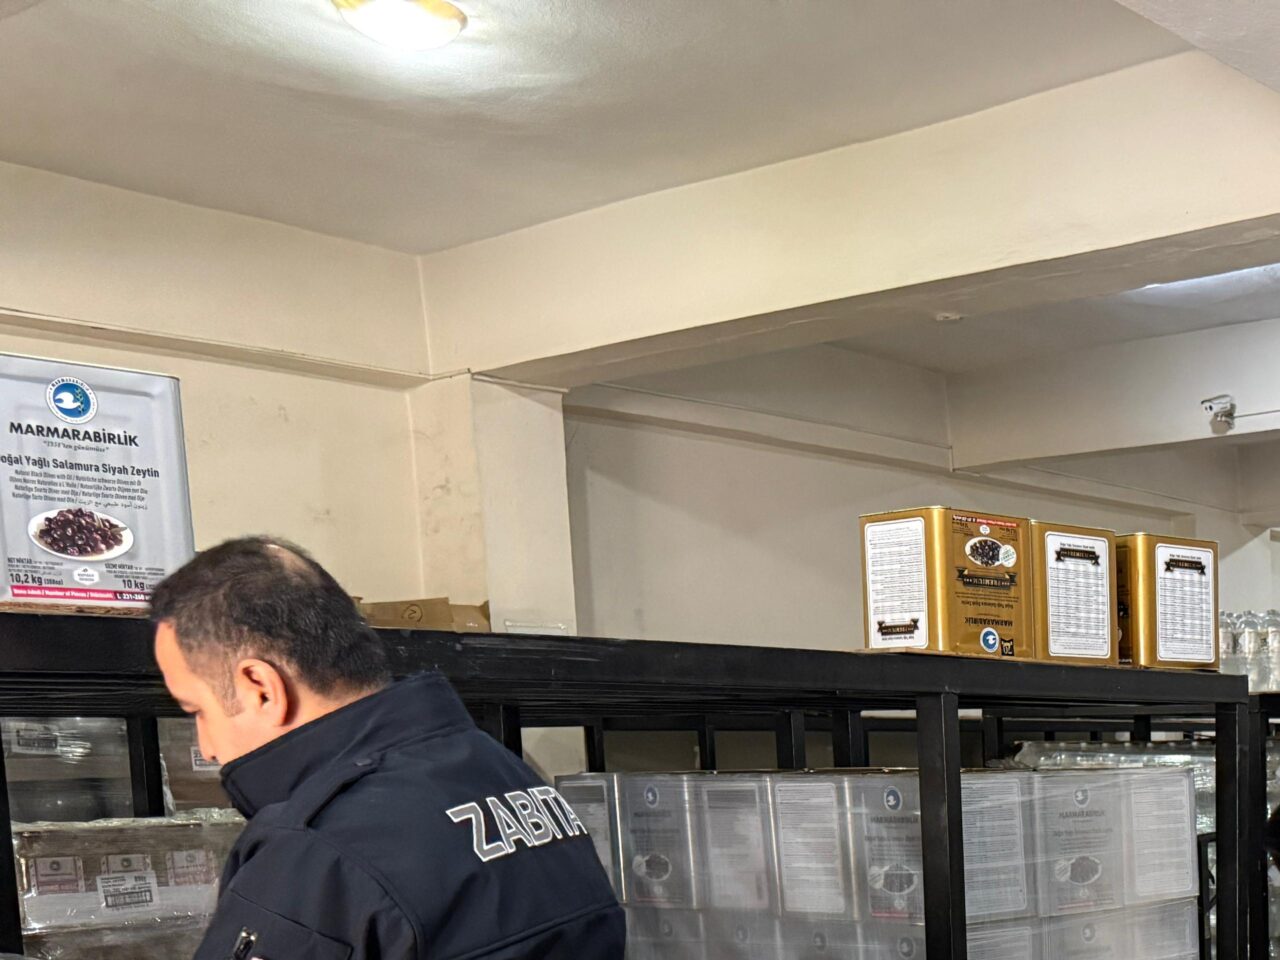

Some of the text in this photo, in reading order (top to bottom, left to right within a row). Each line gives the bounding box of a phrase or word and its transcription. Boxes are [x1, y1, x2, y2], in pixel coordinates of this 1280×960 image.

[9, 422, 140, 447] MARMARABİRLİK
[0, 454, 160, 479] oğal Yağlı Salamura Siyah Zeytin
[10, 573, 29, 584] 10,2
[31, 574, 42, 586] kg
[123, 579, 145, 591] 10 kg
[446, 786, 588, 862] ZABITA
